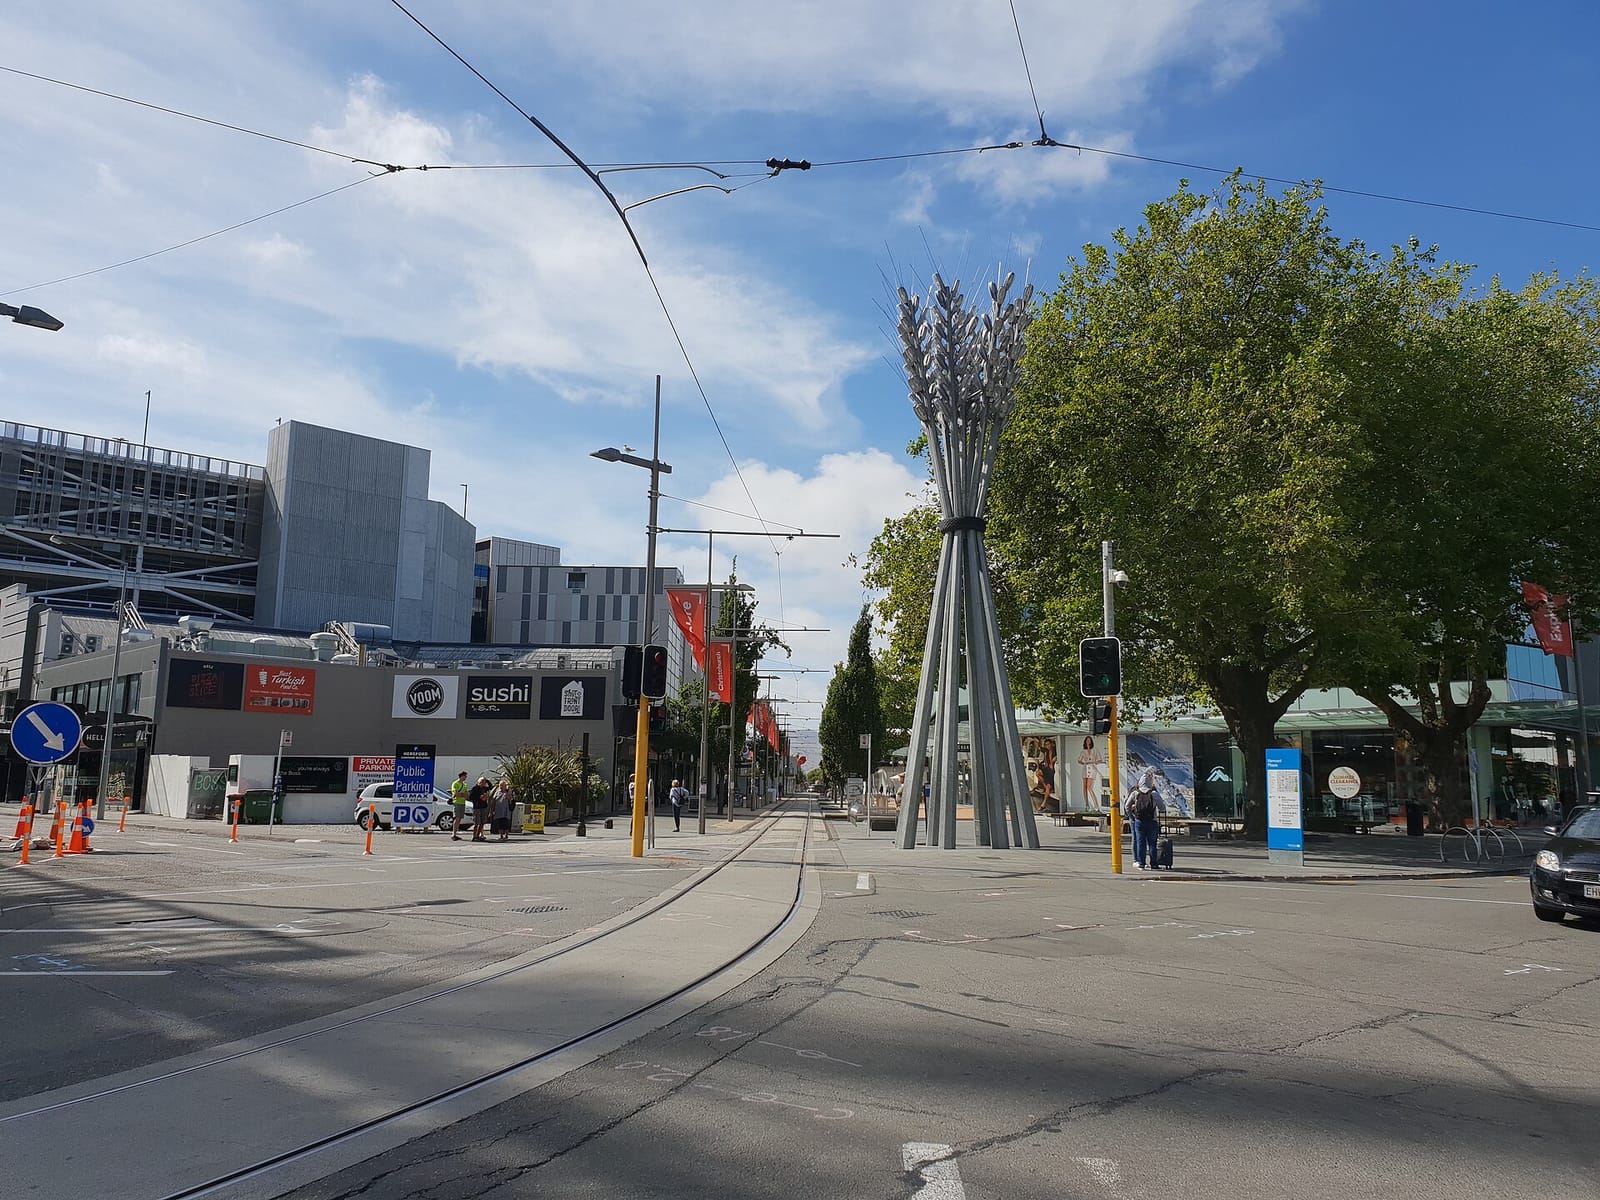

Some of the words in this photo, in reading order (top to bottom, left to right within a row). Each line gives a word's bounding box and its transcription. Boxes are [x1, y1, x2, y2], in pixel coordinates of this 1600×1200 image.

[271, 675, 306, 686] Turkish
[409, 687, 441, 706] VOOM
[471, 683, 529, 701] sushi
[86, 733, 105, 741] HELL
[396, 765, 426, 777] Public
[395, 781, 431, 796] Parking
